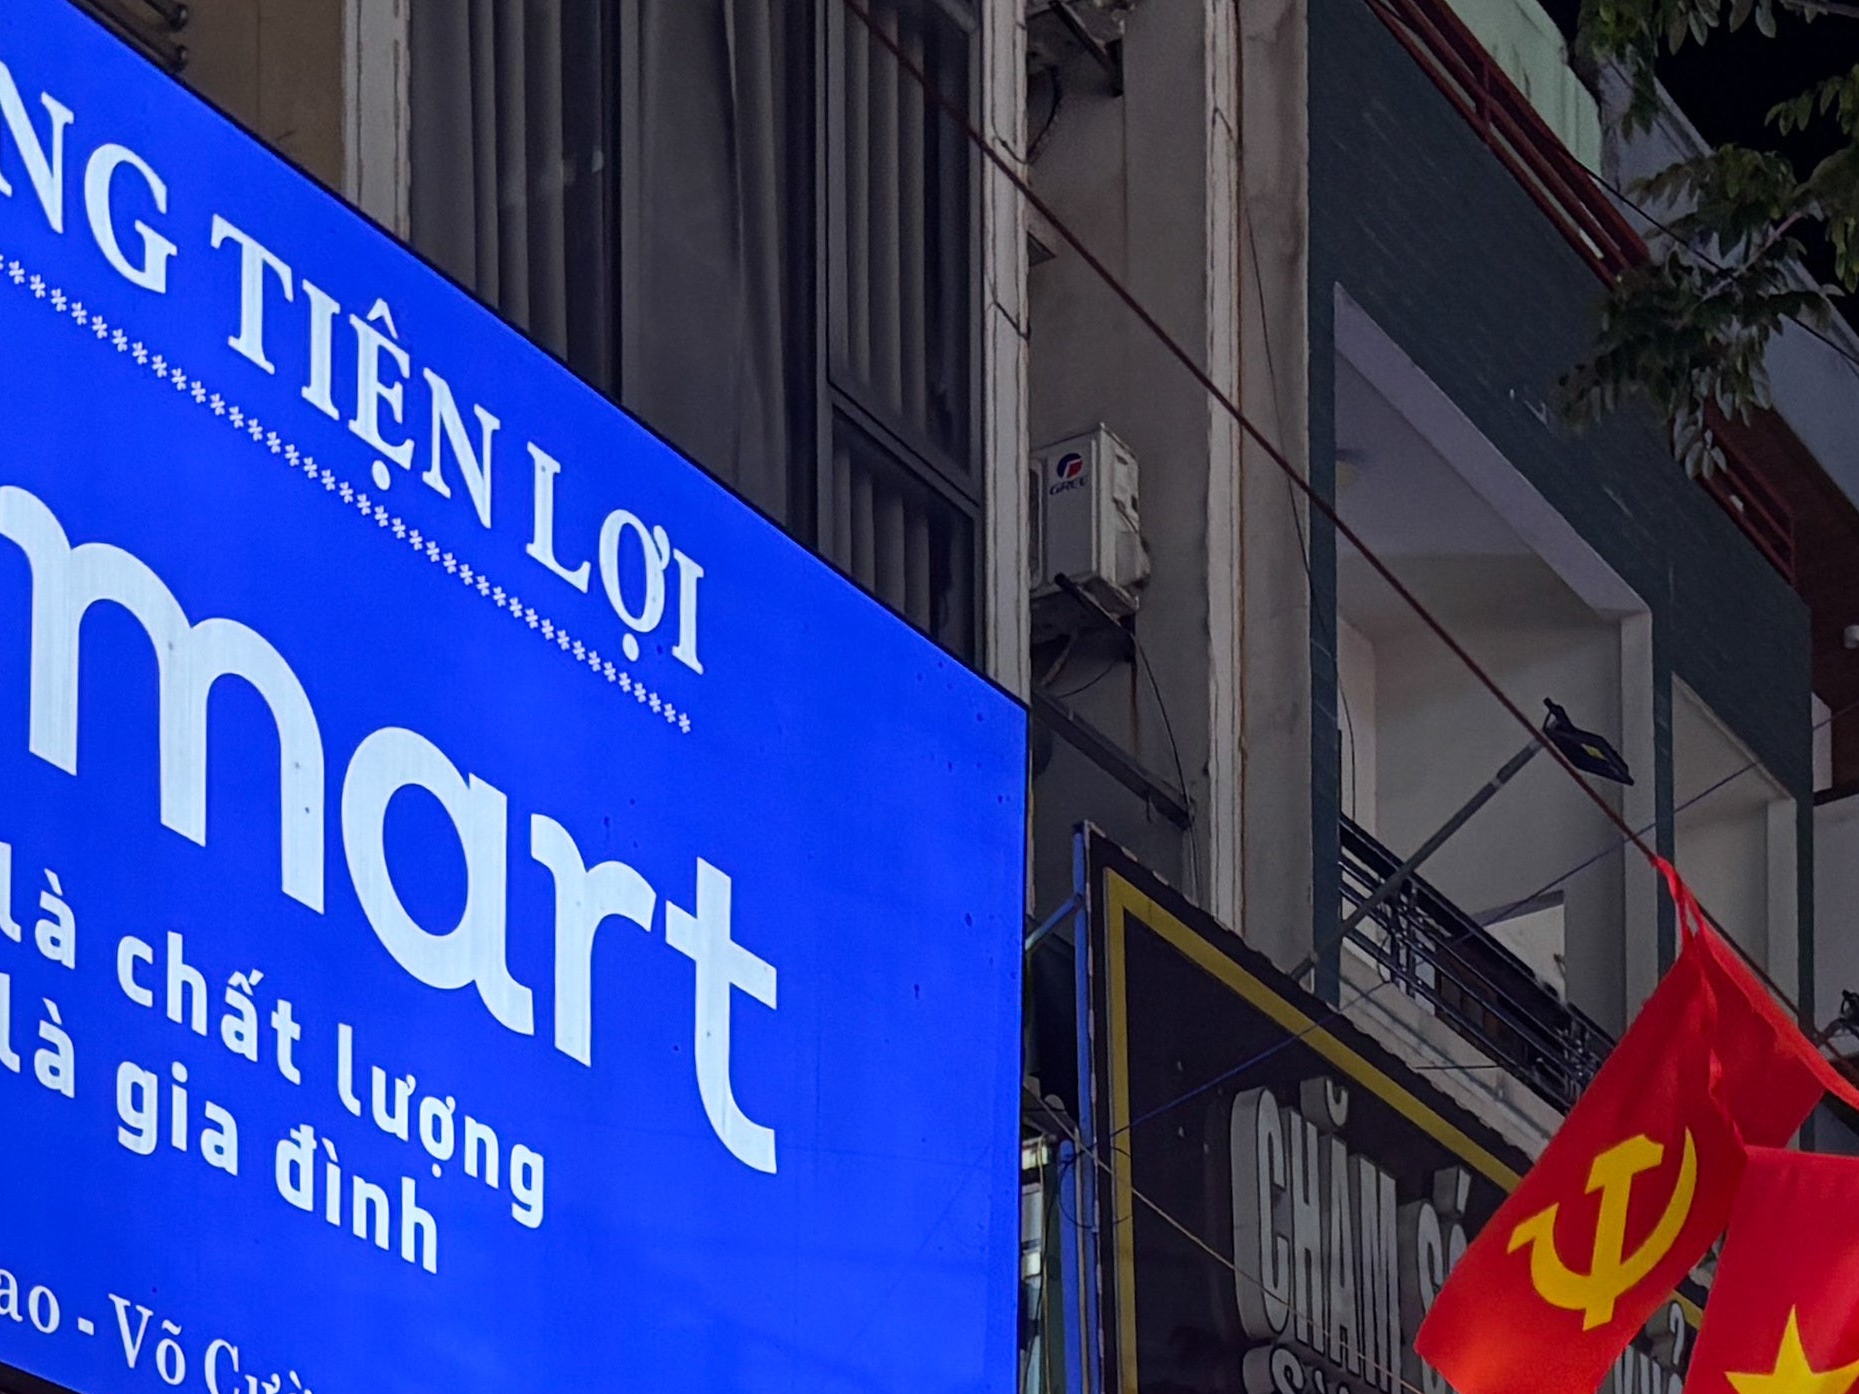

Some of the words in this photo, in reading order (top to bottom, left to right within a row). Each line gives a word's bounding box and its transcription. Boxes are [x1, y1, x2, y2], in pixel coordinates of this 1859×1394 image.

[212, 213, 501, 528] TIỆN
[525, 440, 706, 675] LỢI
[117, 930, 302, 1085] chất
[339, 1024, 544, 1230] lượng
[117, 1061, 238, 1177] gia
[275, 1126, 438, 1275] đình
[109, 1294, 187, 1387] Võ
